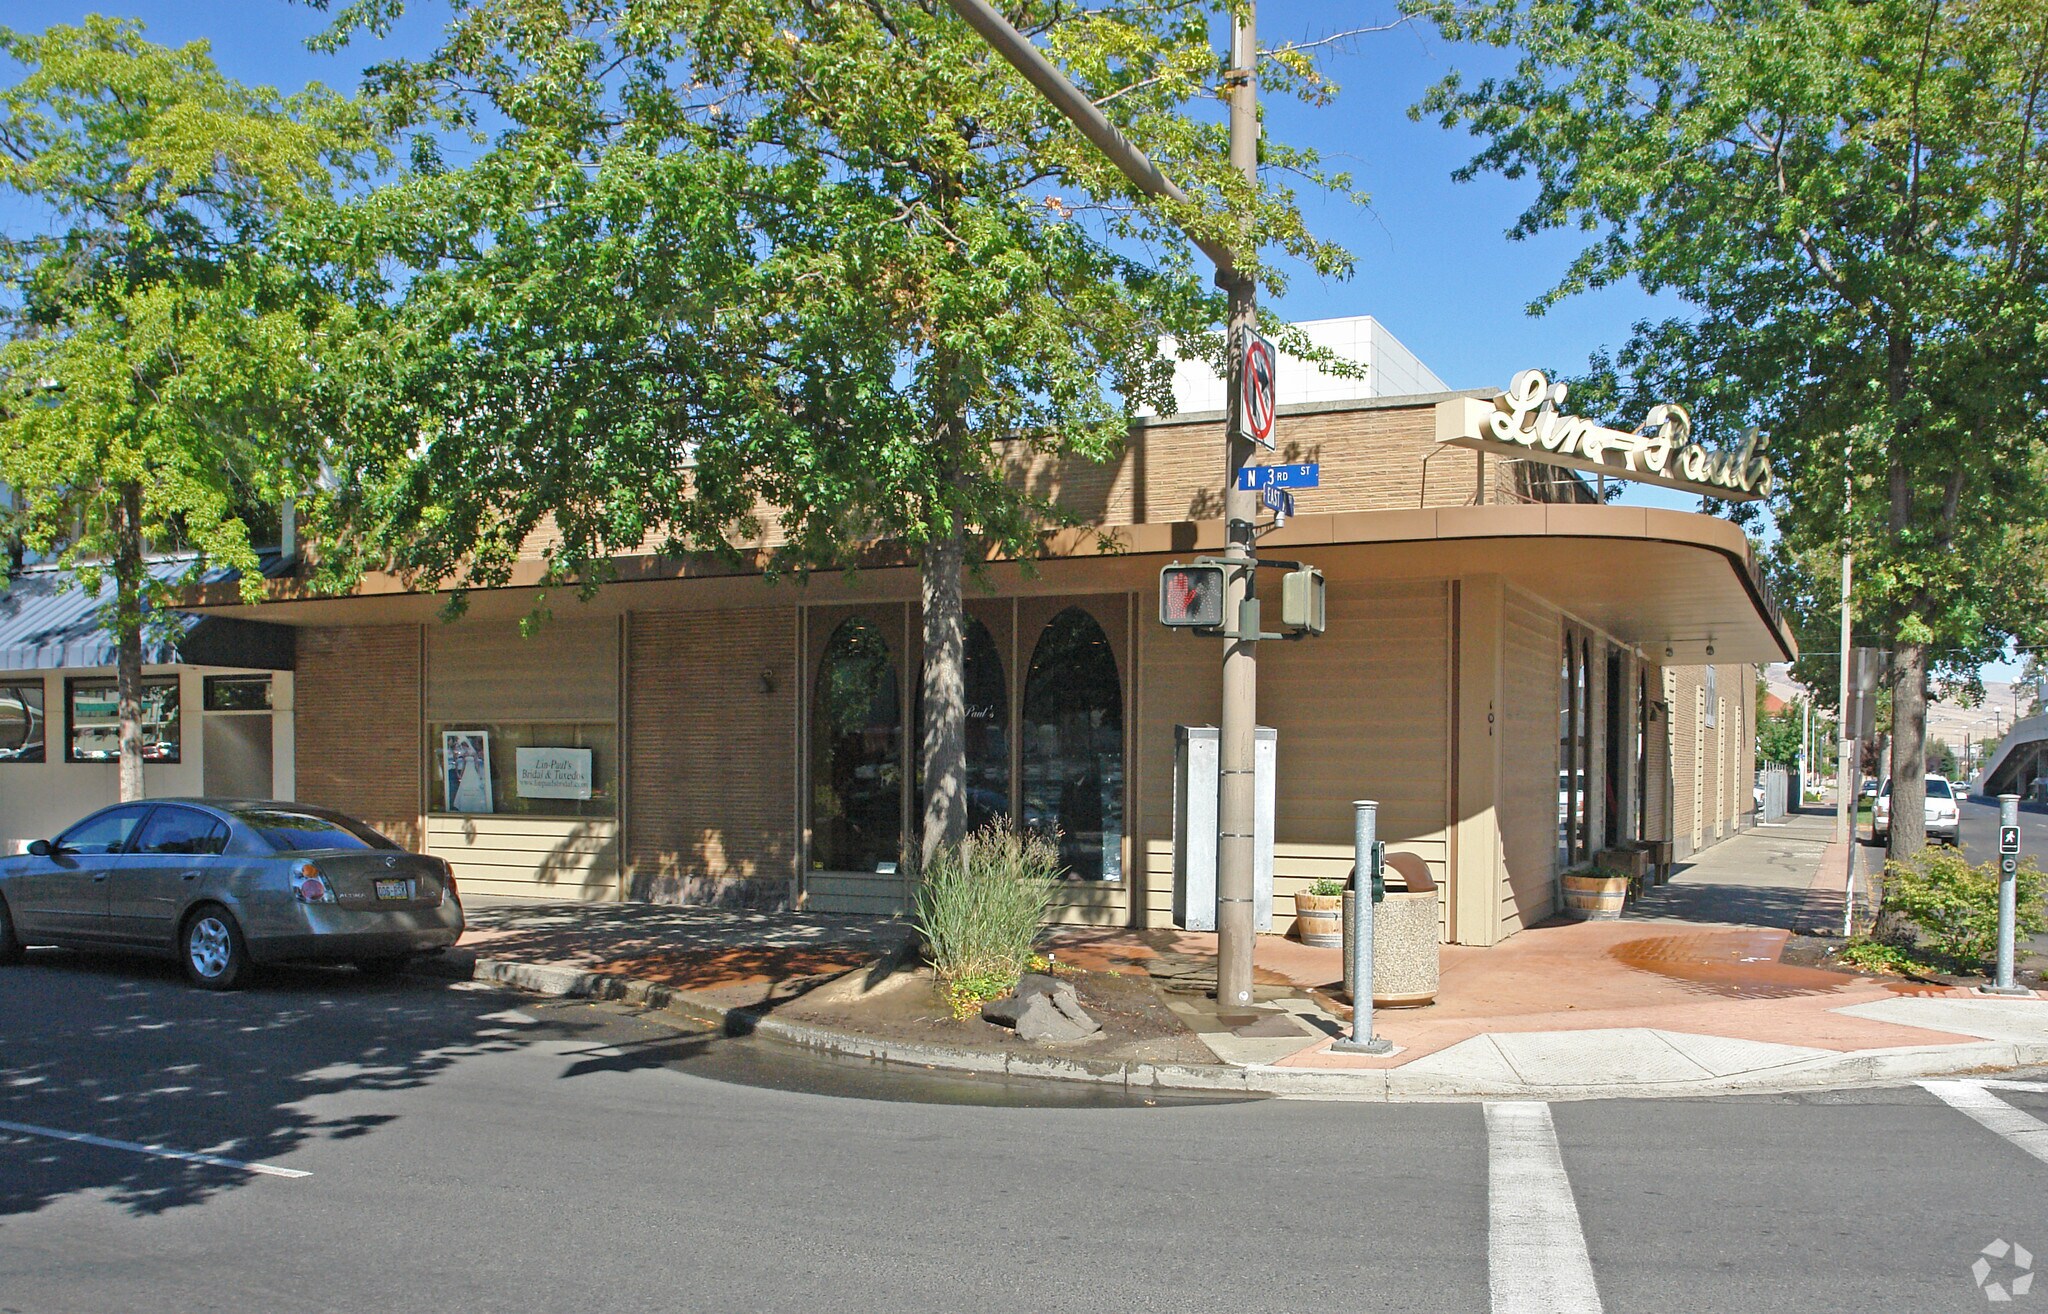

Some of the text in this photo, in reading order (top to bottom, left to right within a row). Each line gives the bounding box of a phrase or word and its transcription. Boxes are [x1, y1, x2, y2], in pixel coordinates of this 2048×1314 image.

[1247, 470, 1256, 487] N
[1300, 466, 1311, 475] ST
[1267, 486, 1280, 508] EAST
[535, 759, 572, 770] Lin-Paul's
[522, 769, 585, 781] Bridal & Tuxedos
